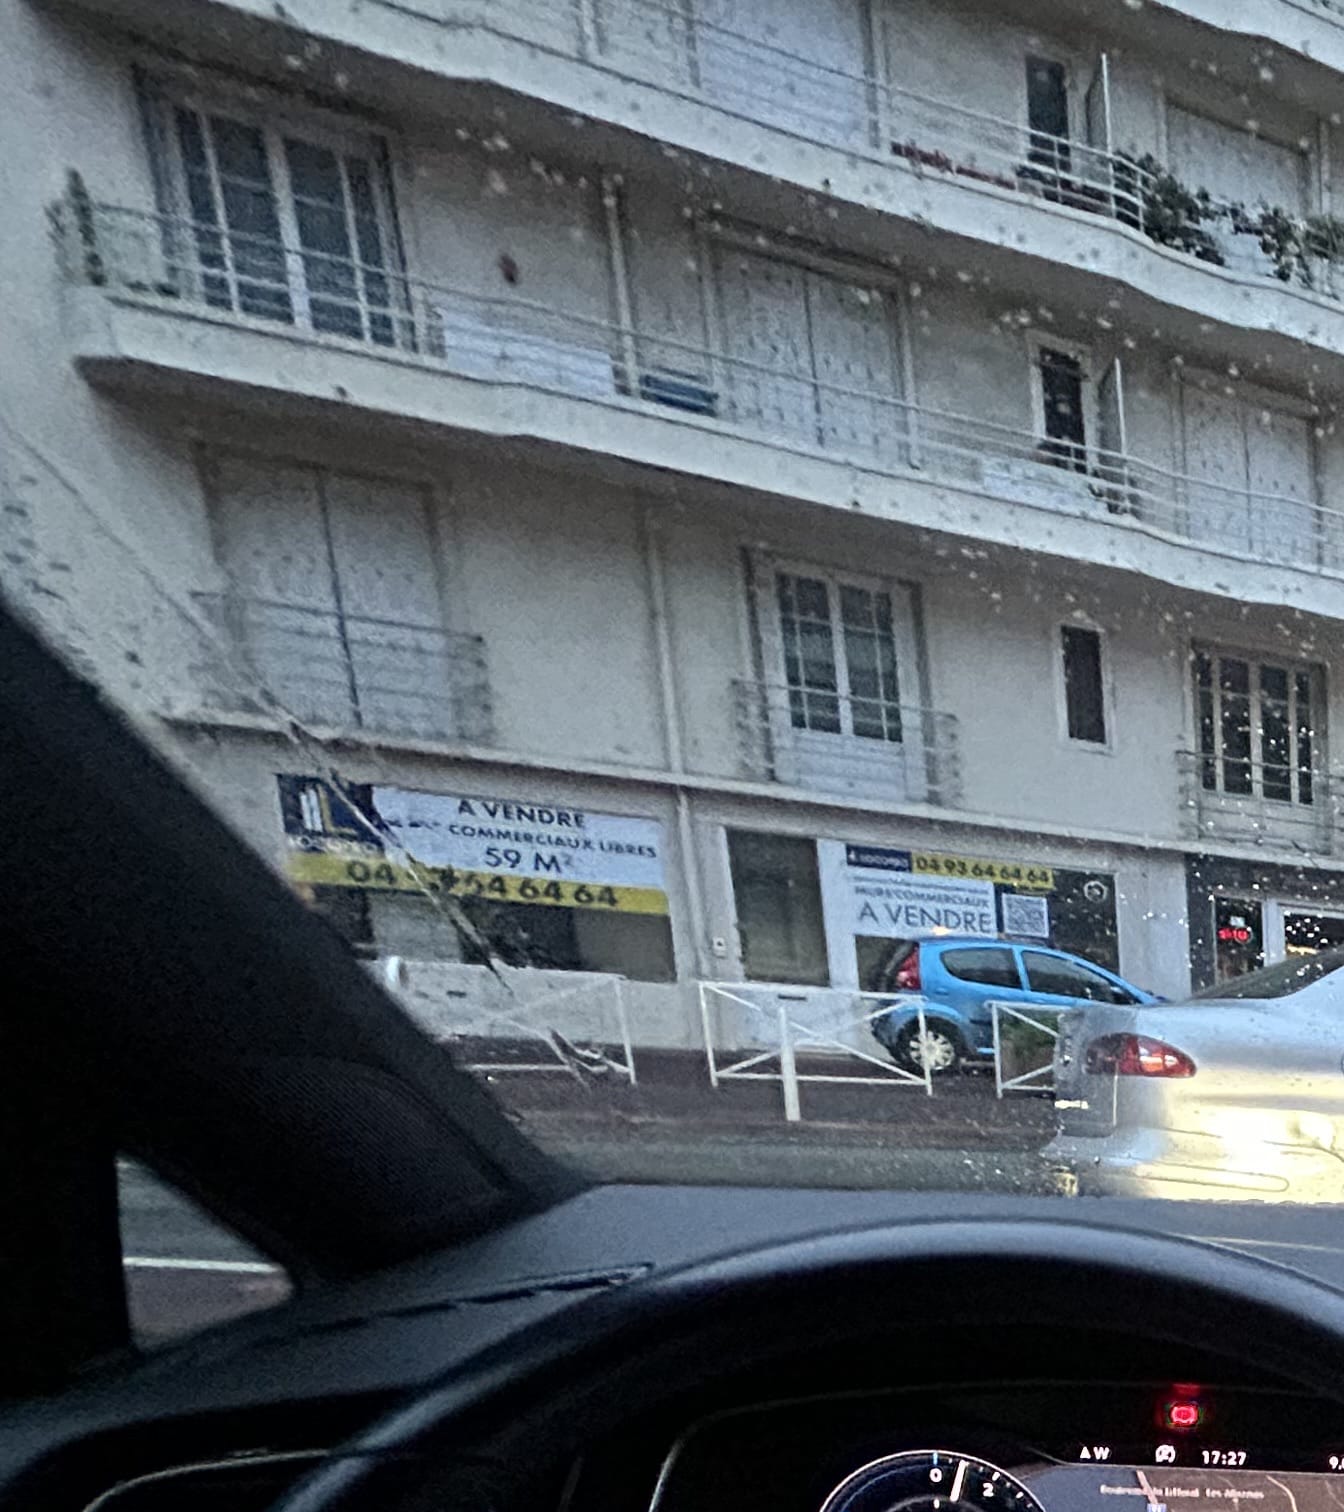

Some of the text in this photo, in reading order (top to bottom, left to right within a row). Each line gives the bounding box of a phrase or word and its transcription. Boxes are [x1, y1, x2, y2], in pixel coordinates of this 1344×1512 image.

[458, 800, 586, 829] A VENDRE
[449, 824, 596, 849] COMMERCIAUX
[600, 841, 657, 858] LIBRES
[485, 847, 522, 868] 59
[347, 860, 396, 885] 04
[916, 857, 940, 871] 04
[944, 859, 967, 876] 93
[971, 864, 996, 878] 64
[1027, 868, 1050, 883] 64
[859, 901, 993, 933] A VENDRE
[1093, 1447, 1110, 1460] W
[1201, 1450, 1247, 1465] 17:27
[930, 1468, 942, 1483] 0
[983, 1483, 994, 1497] 2
